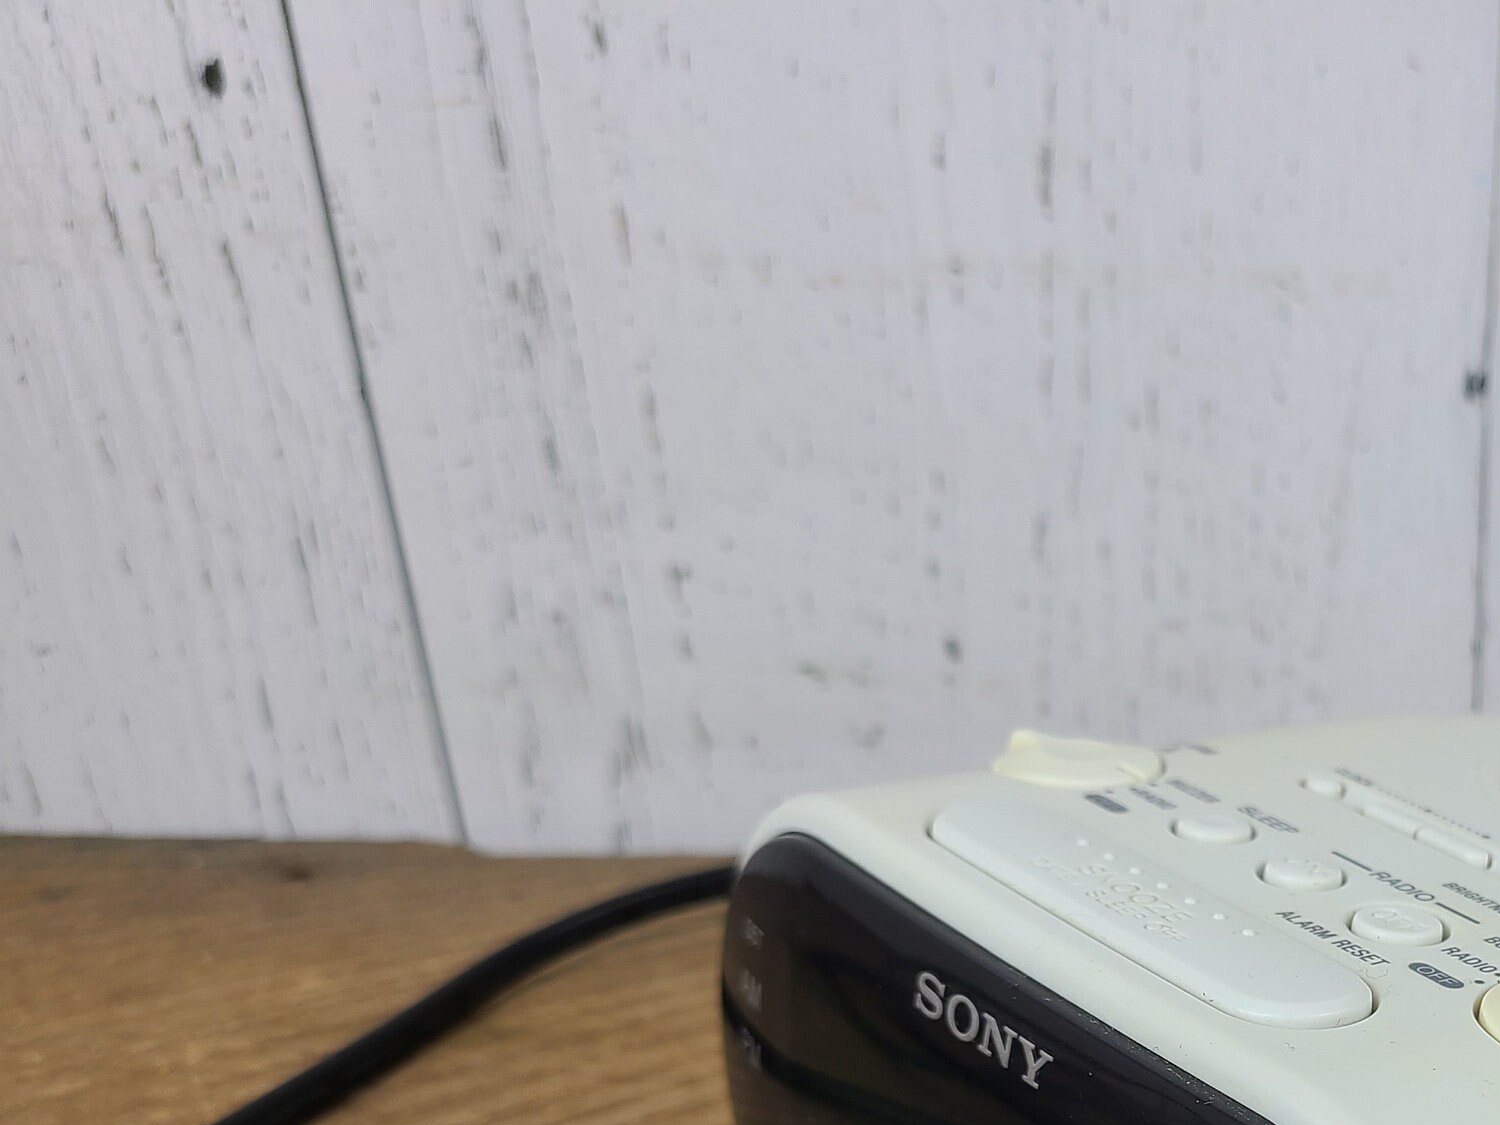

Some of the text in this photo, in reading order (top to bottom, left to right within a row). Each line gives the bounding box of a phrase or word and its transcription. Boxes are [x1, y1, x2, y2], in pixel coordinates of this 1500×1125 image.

[1369, 871, 1435, 902] RADIO
[1275, 910, 1391, 966] ALARM RESET
[1441, 946, 1497, 974] RADIO
[1415, 965, 1459, 987] OFF
[913, 970, 1054, 1090] SONY
